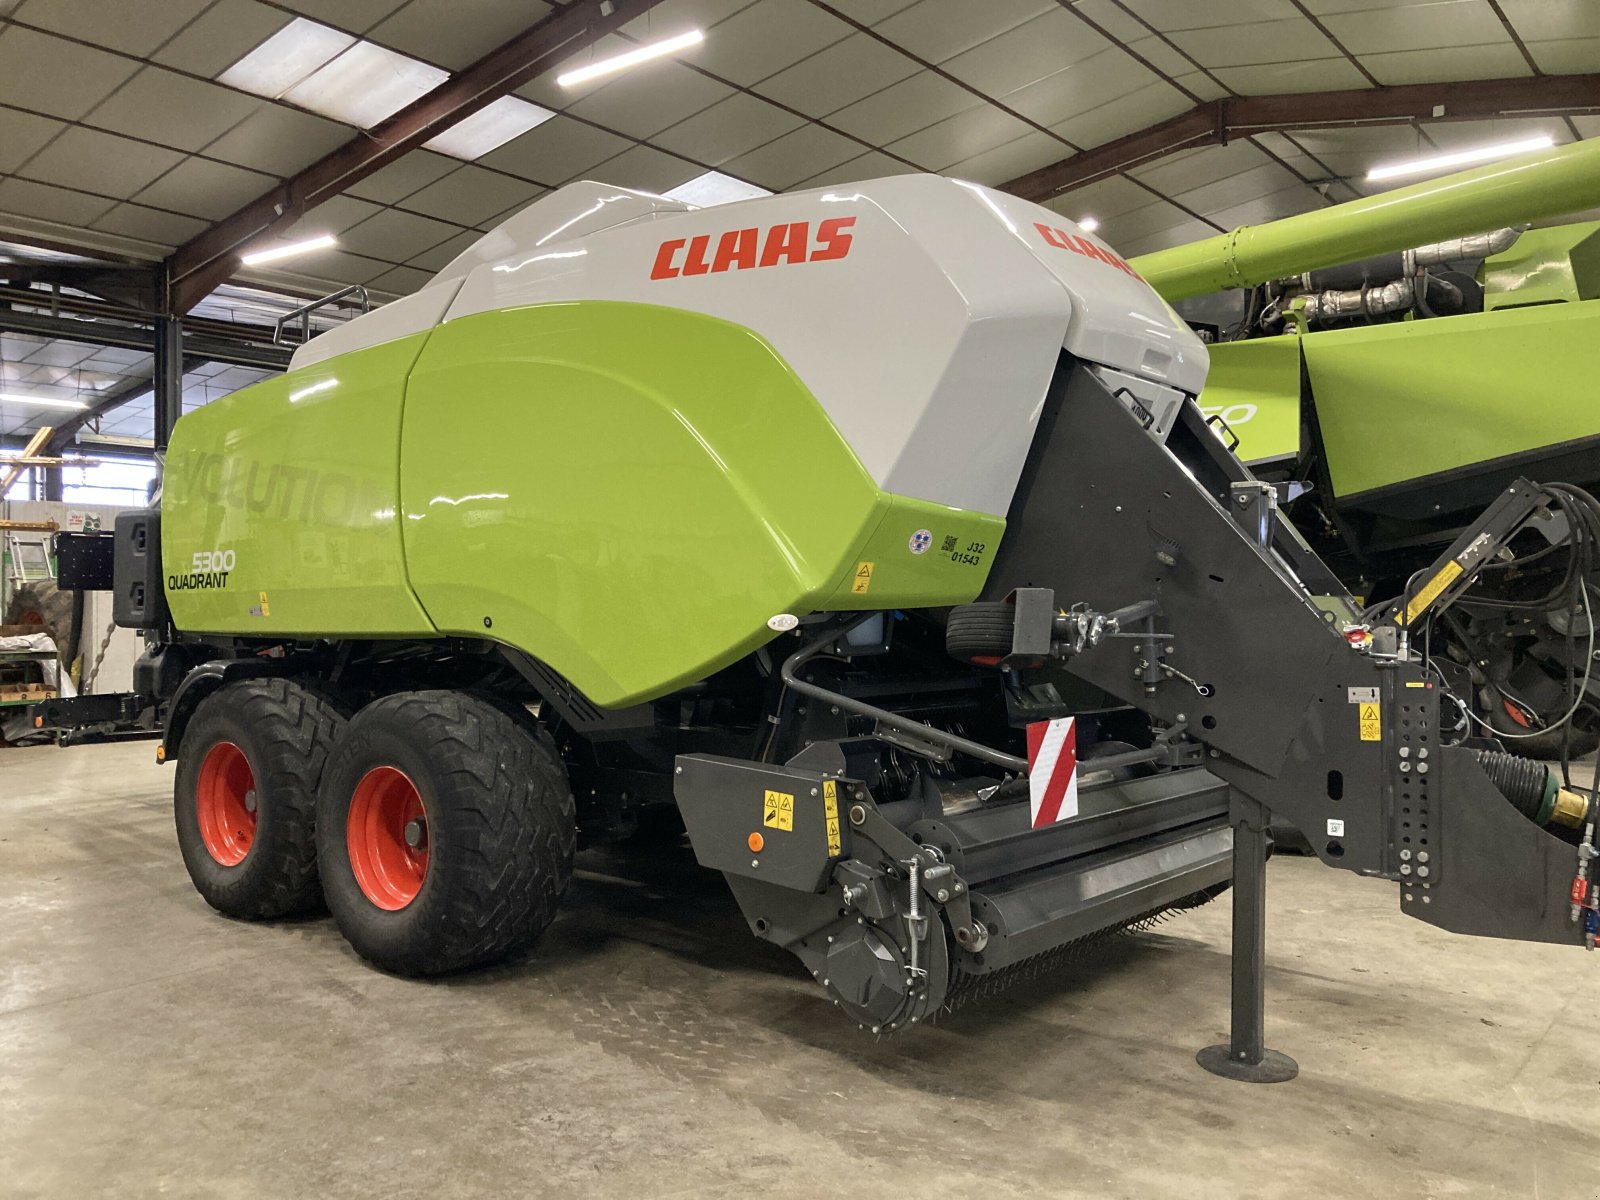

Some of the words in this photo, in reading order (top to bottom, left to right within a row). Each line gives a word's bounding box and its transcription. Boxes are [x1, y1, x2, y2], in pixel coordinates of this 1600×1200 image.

[650, 216, 857, 281] CLAAS
[967, 541, 985, 554] J32
[192, 549, 236, 574] 5300
[951, 551, 980, 566] 01543
[168, 571, 228, 591] QUADRANT
